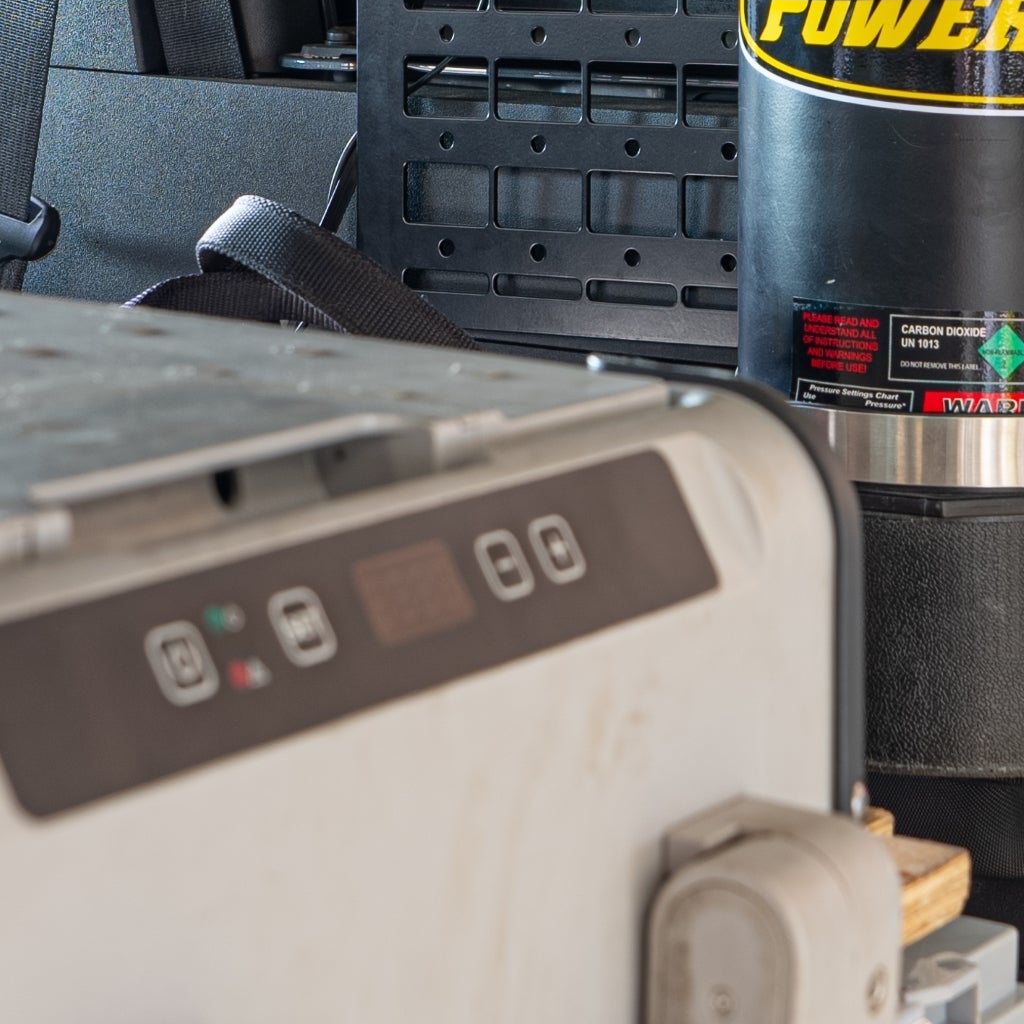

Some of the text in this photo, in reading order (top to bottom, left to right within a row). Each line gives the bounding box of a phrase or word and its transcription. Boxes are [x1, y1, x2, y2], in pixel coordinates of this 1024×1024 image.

[803, 312, 880, 328] PLEASE READ AND
[803, 324, 877, 339] UNDERSTAND ALL
[901, 324, 987, 338] CARBON DIOXIDE
[803, 335, 880, 352] OF INSTRUCTIONS
[901, 338, 940, 349] UN 1013
[807, 347, 873, 363] AND WARNINGS
[811, 359, 844, 372] BEFORE
[900, 360, 908, 368] DO
[923, 362, 947, 370] REMOVE
[948, 362, 961, 370] THIS
[803, 392, 816, 400] Use
[809, 384, 899, 401] Pressure Settings Chart
